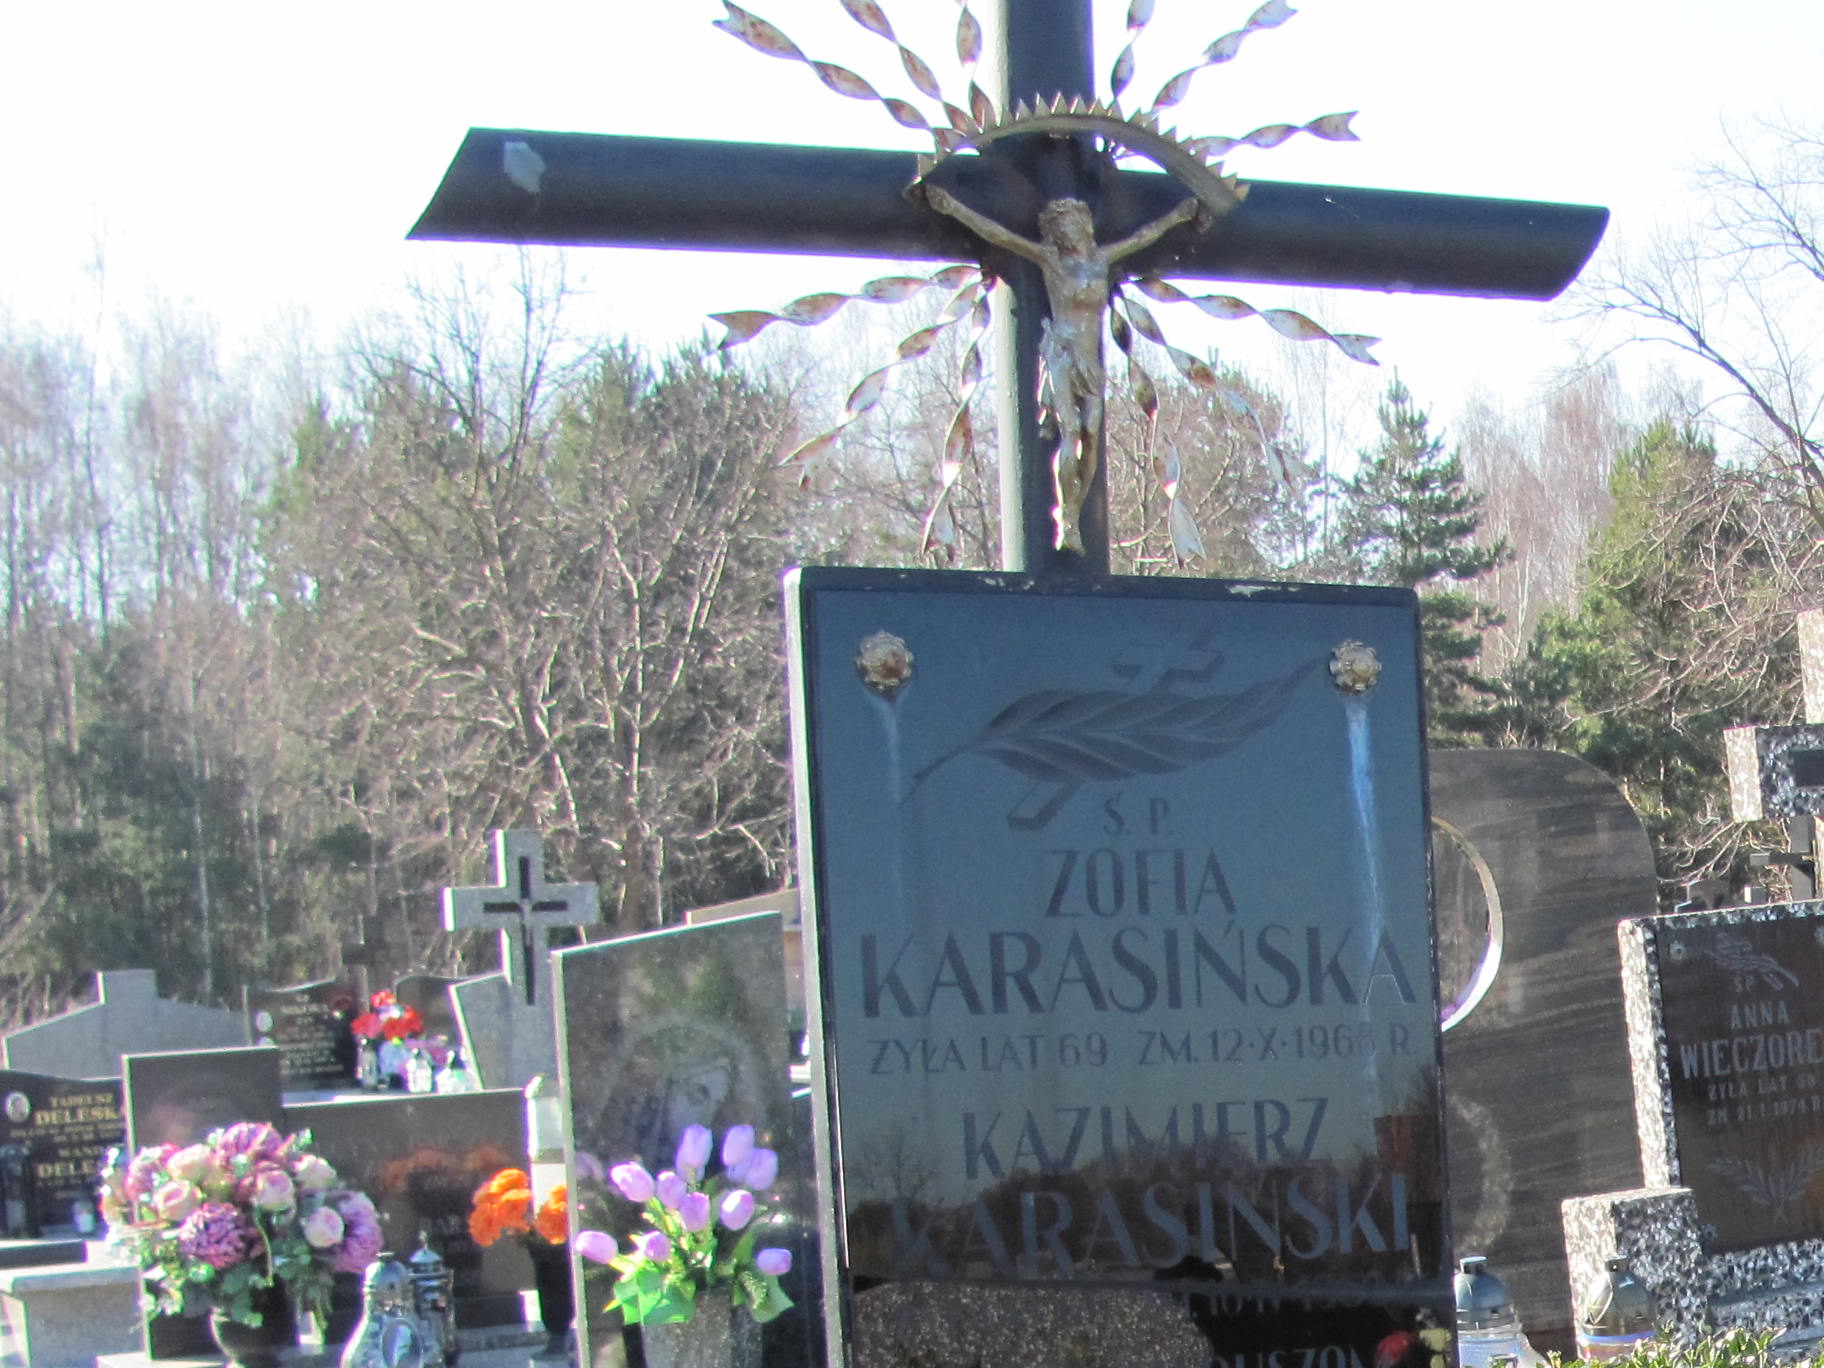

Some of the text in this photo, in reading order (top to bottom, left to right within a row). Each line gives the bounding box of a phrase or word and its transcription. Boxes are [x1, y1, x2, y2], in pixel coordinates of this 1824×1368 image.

[1044, 848, 1237, 920] ZOFIA
[861, 918, 1417, 1019] KARASIŃSKA
[1730, 1000, 1790, 1030] ANNA
[979, 1034, 1045, 1072] LAT
[1057, 1030, 1108, 1068] 69
[1758, 1076, 1788, 1094] LAT
[963, 1096, 1329, 1181] KAZIMIERZ
